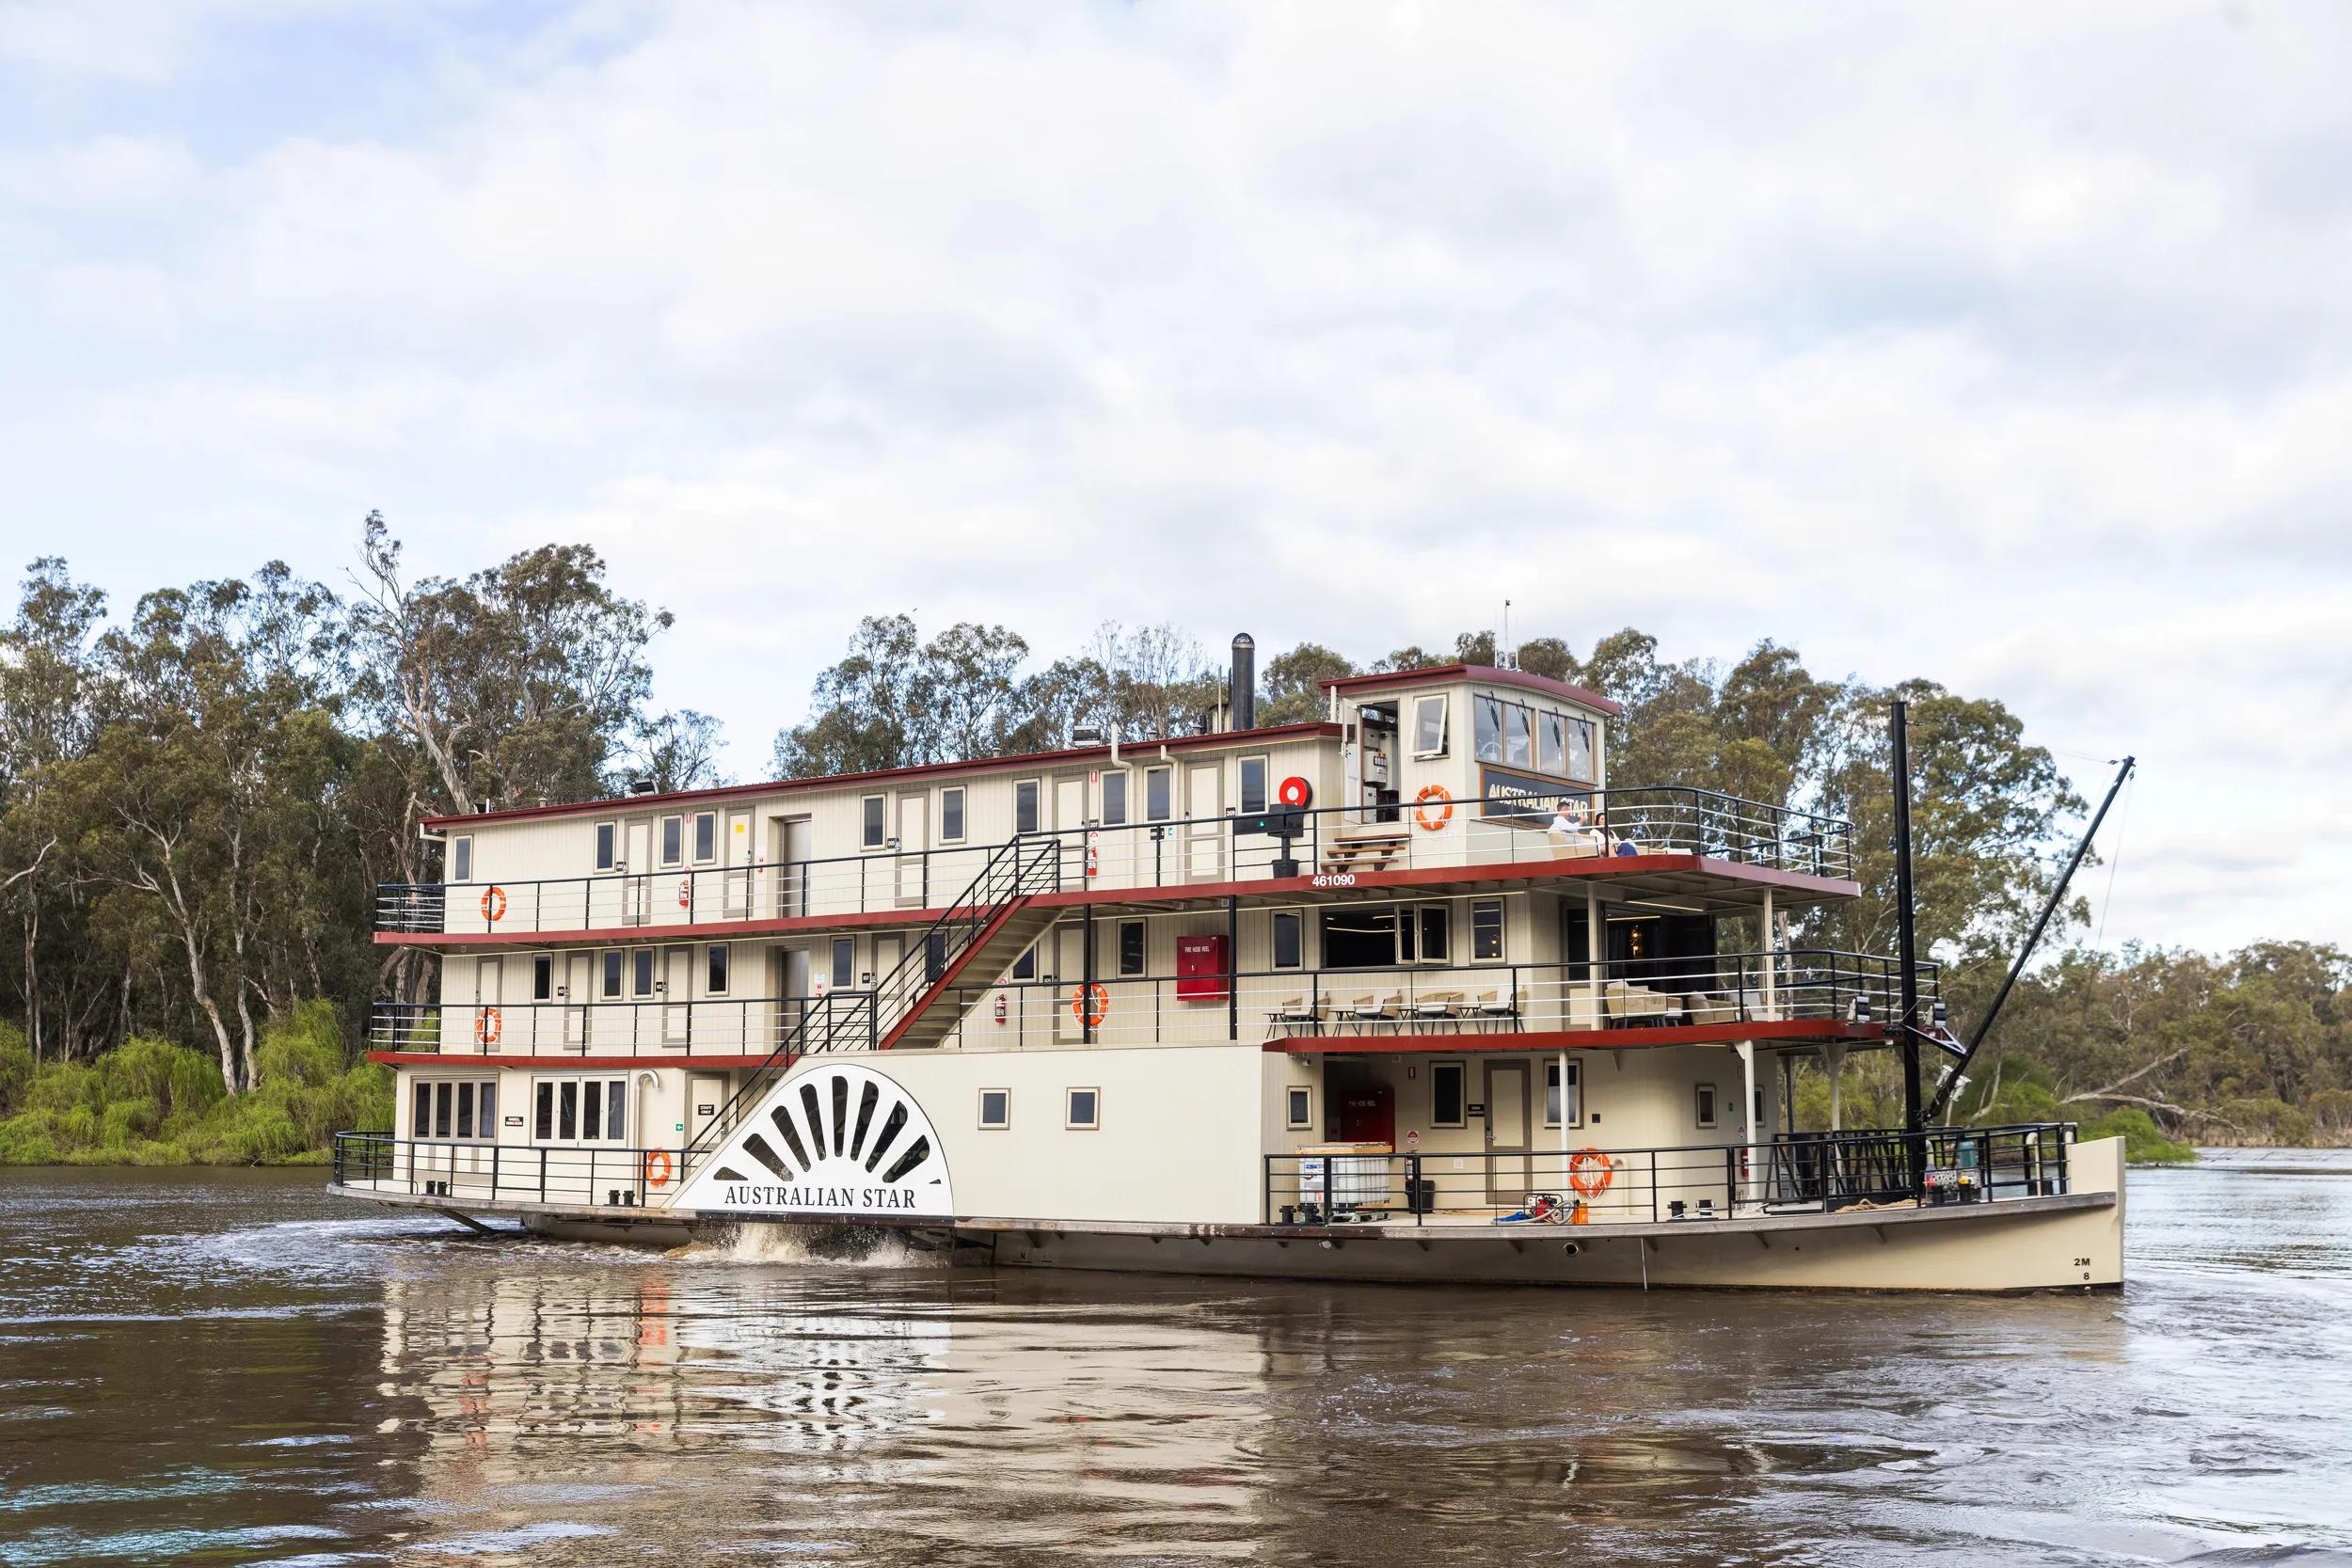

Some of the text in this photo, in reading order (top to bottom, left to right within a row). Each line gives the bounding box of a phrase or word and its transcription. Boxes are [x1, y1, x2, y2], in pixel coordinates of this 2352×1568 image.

[1488, 784, 1559, 813] AUSTRALIAN
[1311, 874, 1356, 887] 461090
[724, 1186, 916, 1209] AUSTRALIAN STAR
[2074, 1258, 2090, 1266] 2M
[2083, 1272, 2090, 1280] 8
